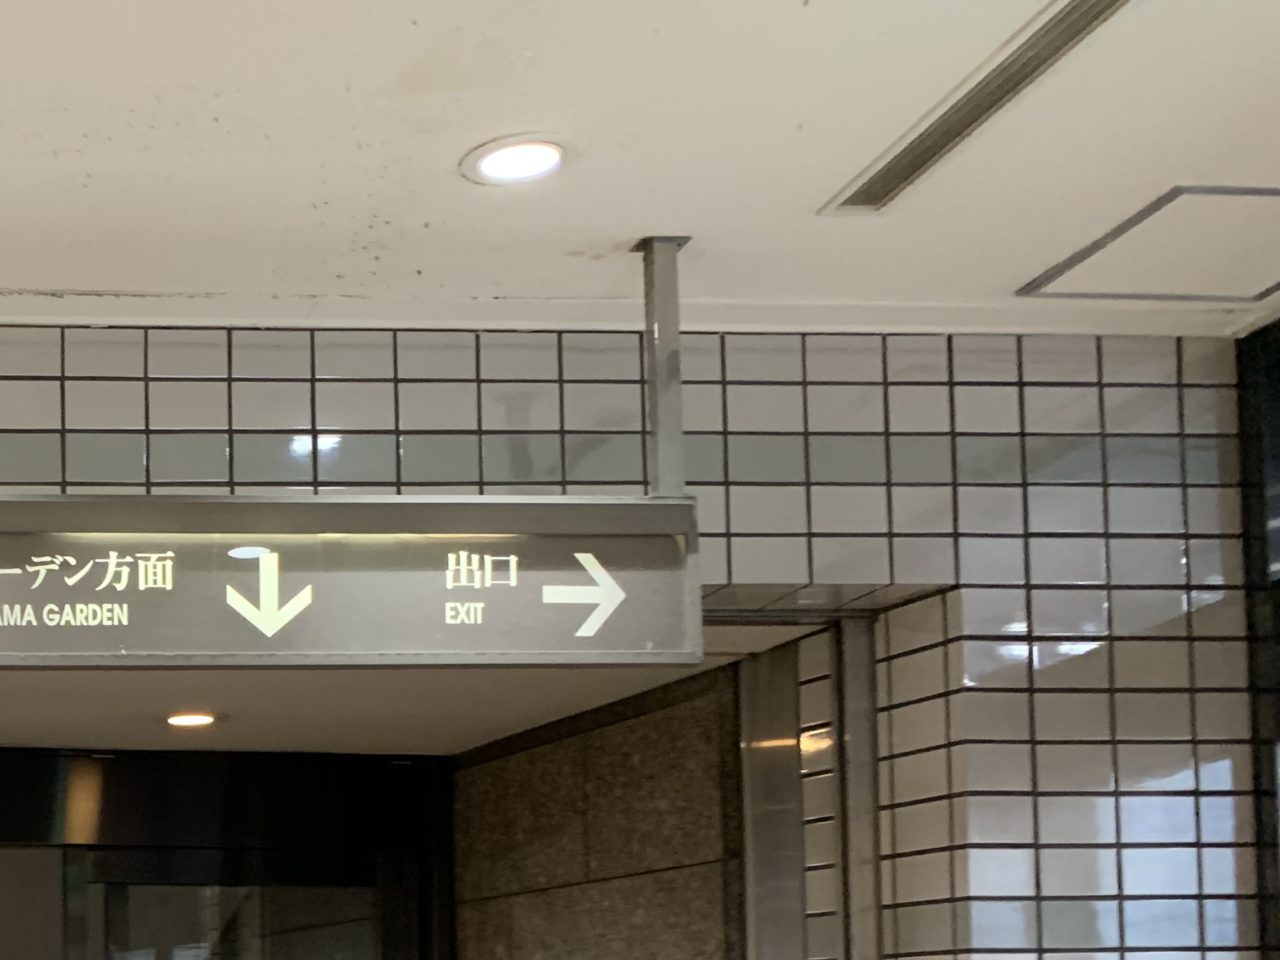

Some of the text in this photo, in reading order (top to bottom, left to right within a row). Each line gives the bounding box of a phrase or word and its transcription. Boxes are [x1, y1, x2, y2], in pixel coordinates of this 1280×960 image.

[445, 550, 519, 589] 出口
[42, 603, 129, 626] GARDEN
[445, 602, 485, 625] EXIT
